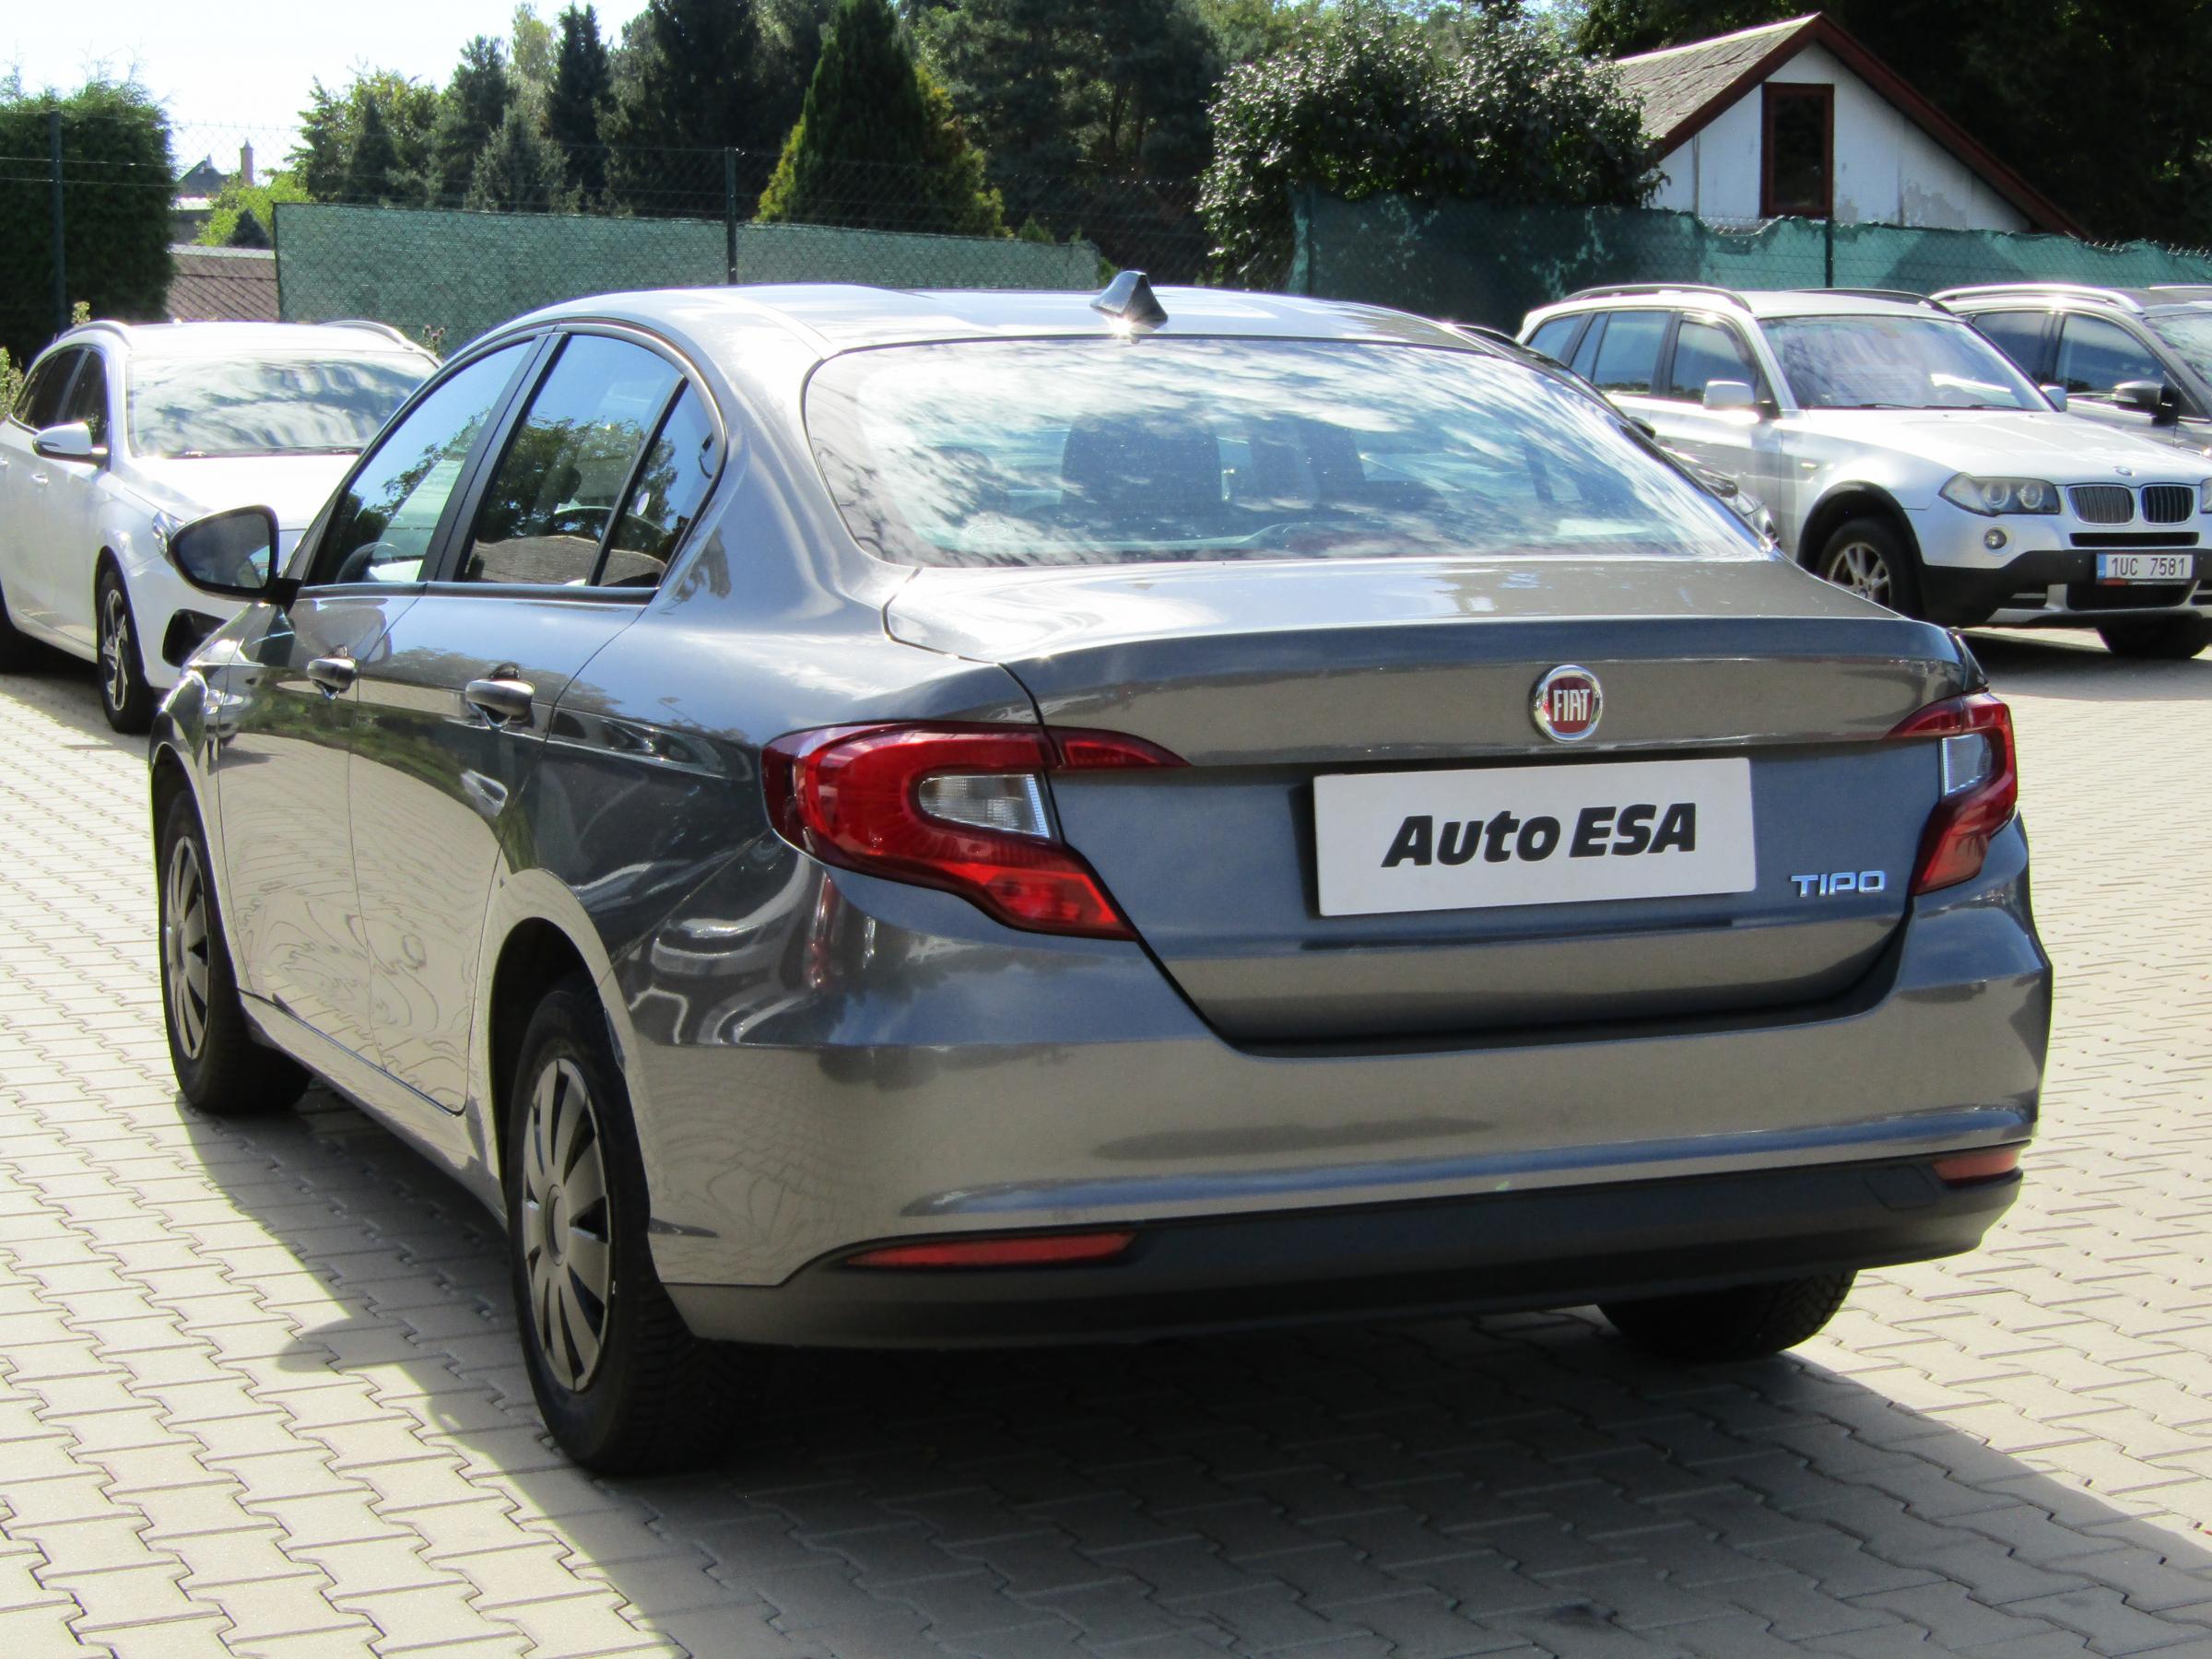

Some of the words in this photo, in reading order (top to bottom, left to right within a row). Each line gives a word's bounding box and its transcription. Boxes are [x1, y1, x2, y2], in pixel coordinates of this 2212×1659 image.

[2112, 558, 2138, 576] 1UC
[2150, 558, 2184, 576] 7581
[1553, 688, 1590, 722] FIAT
[1381, 811, 1560, 867] Auto
[1569, 803, 1696, 858] ESA
[1791, 870, 1885, 897] TIPO
